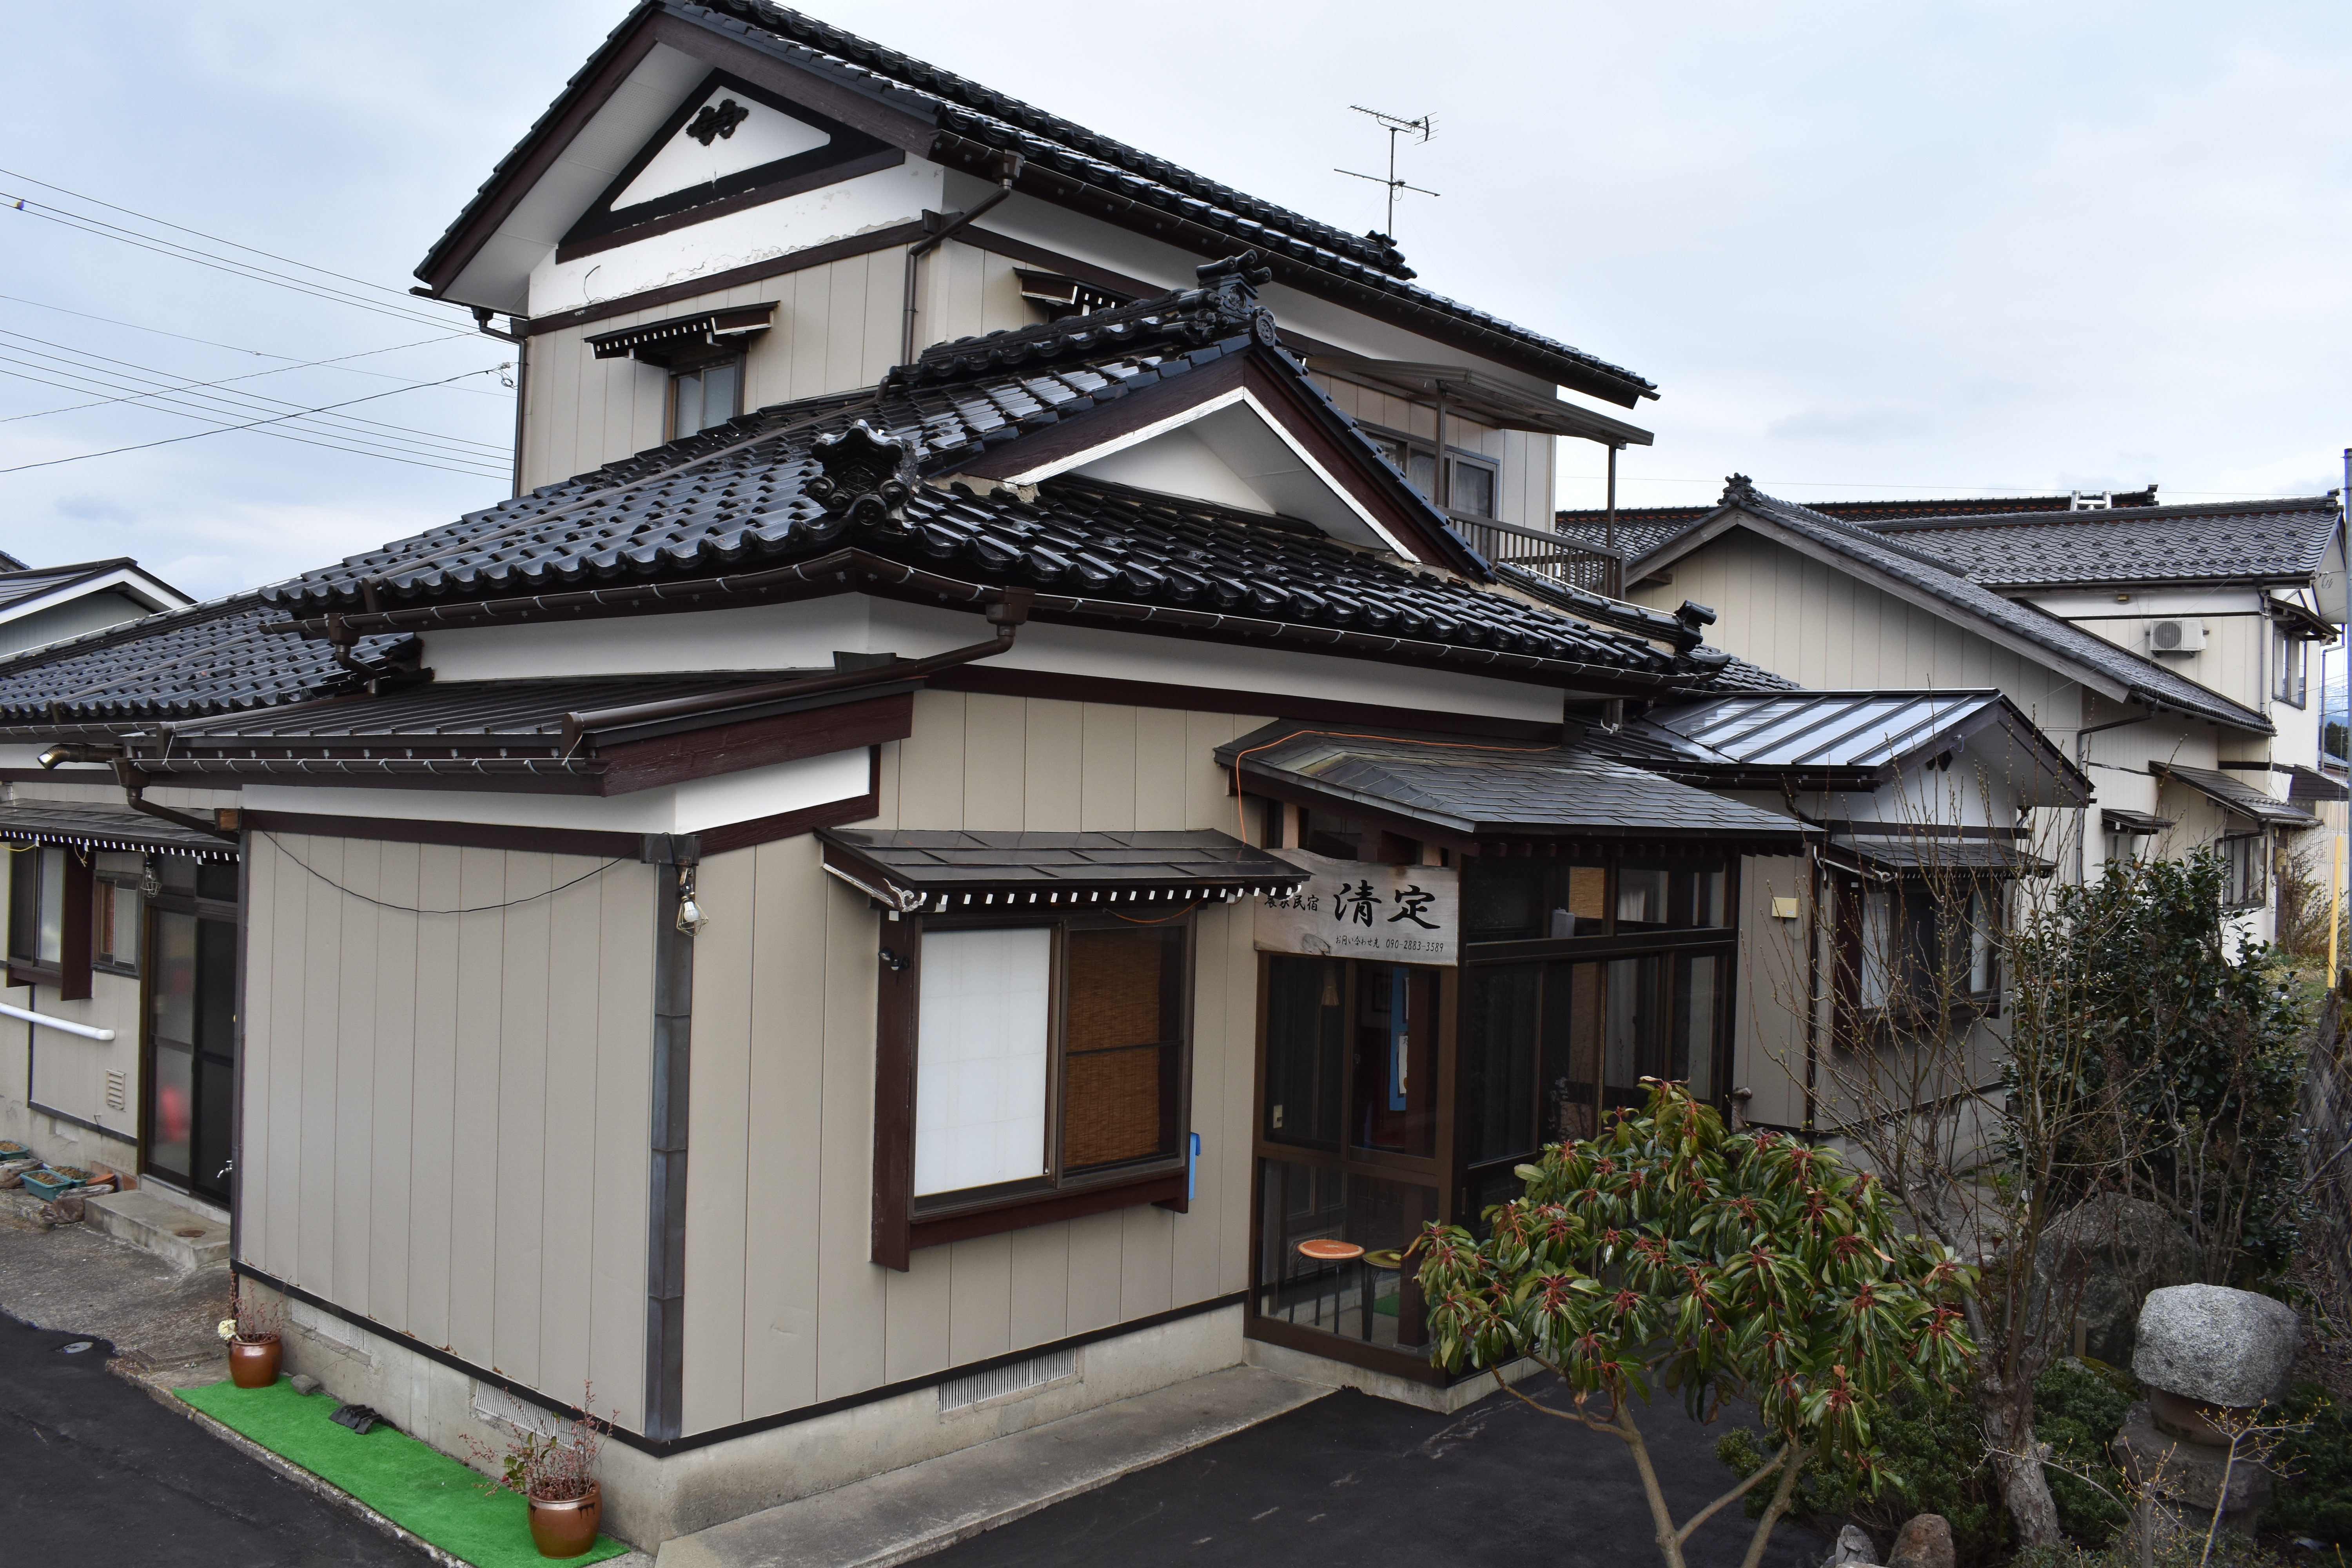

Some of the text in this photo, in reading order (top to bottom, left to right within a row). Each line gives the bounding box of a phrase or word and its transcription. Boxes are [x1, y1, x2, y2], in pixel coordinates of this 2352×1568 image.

[1333, 879, 1441, 929] 清定
[1336, 935, 1443, 952] お問い合わせ先 090-2883-3589
